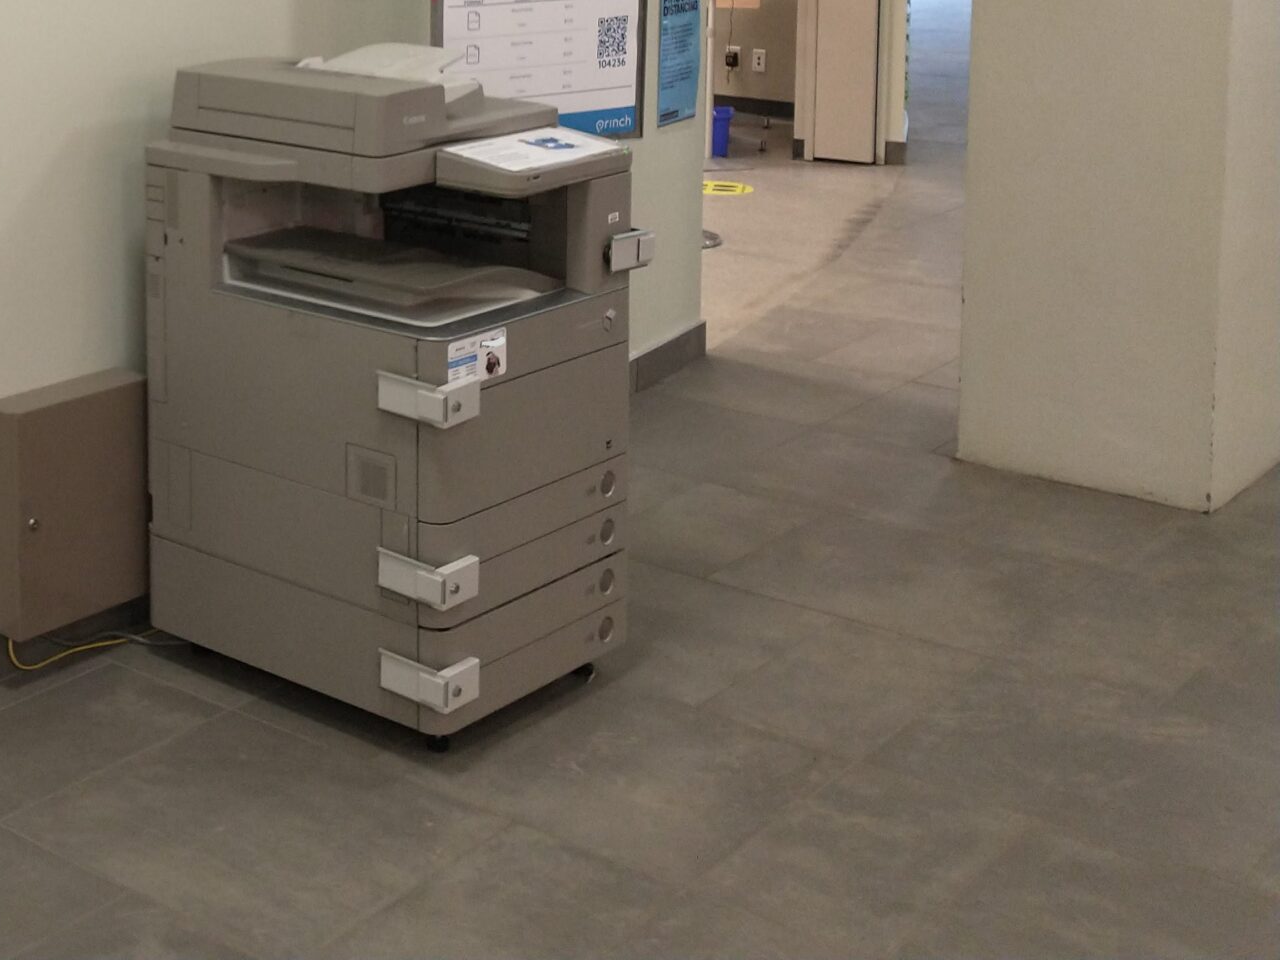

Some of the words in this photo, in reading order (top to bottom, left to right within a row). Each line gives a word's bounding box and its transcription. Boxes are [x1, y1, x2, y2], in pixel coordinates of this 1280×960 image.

[463, 0, 484, 7] FORMAT
[663, 0, 698, 17] DISTANCING
[597, 59, 627, 69] 104236
[595, 114, 632, 133] princh
